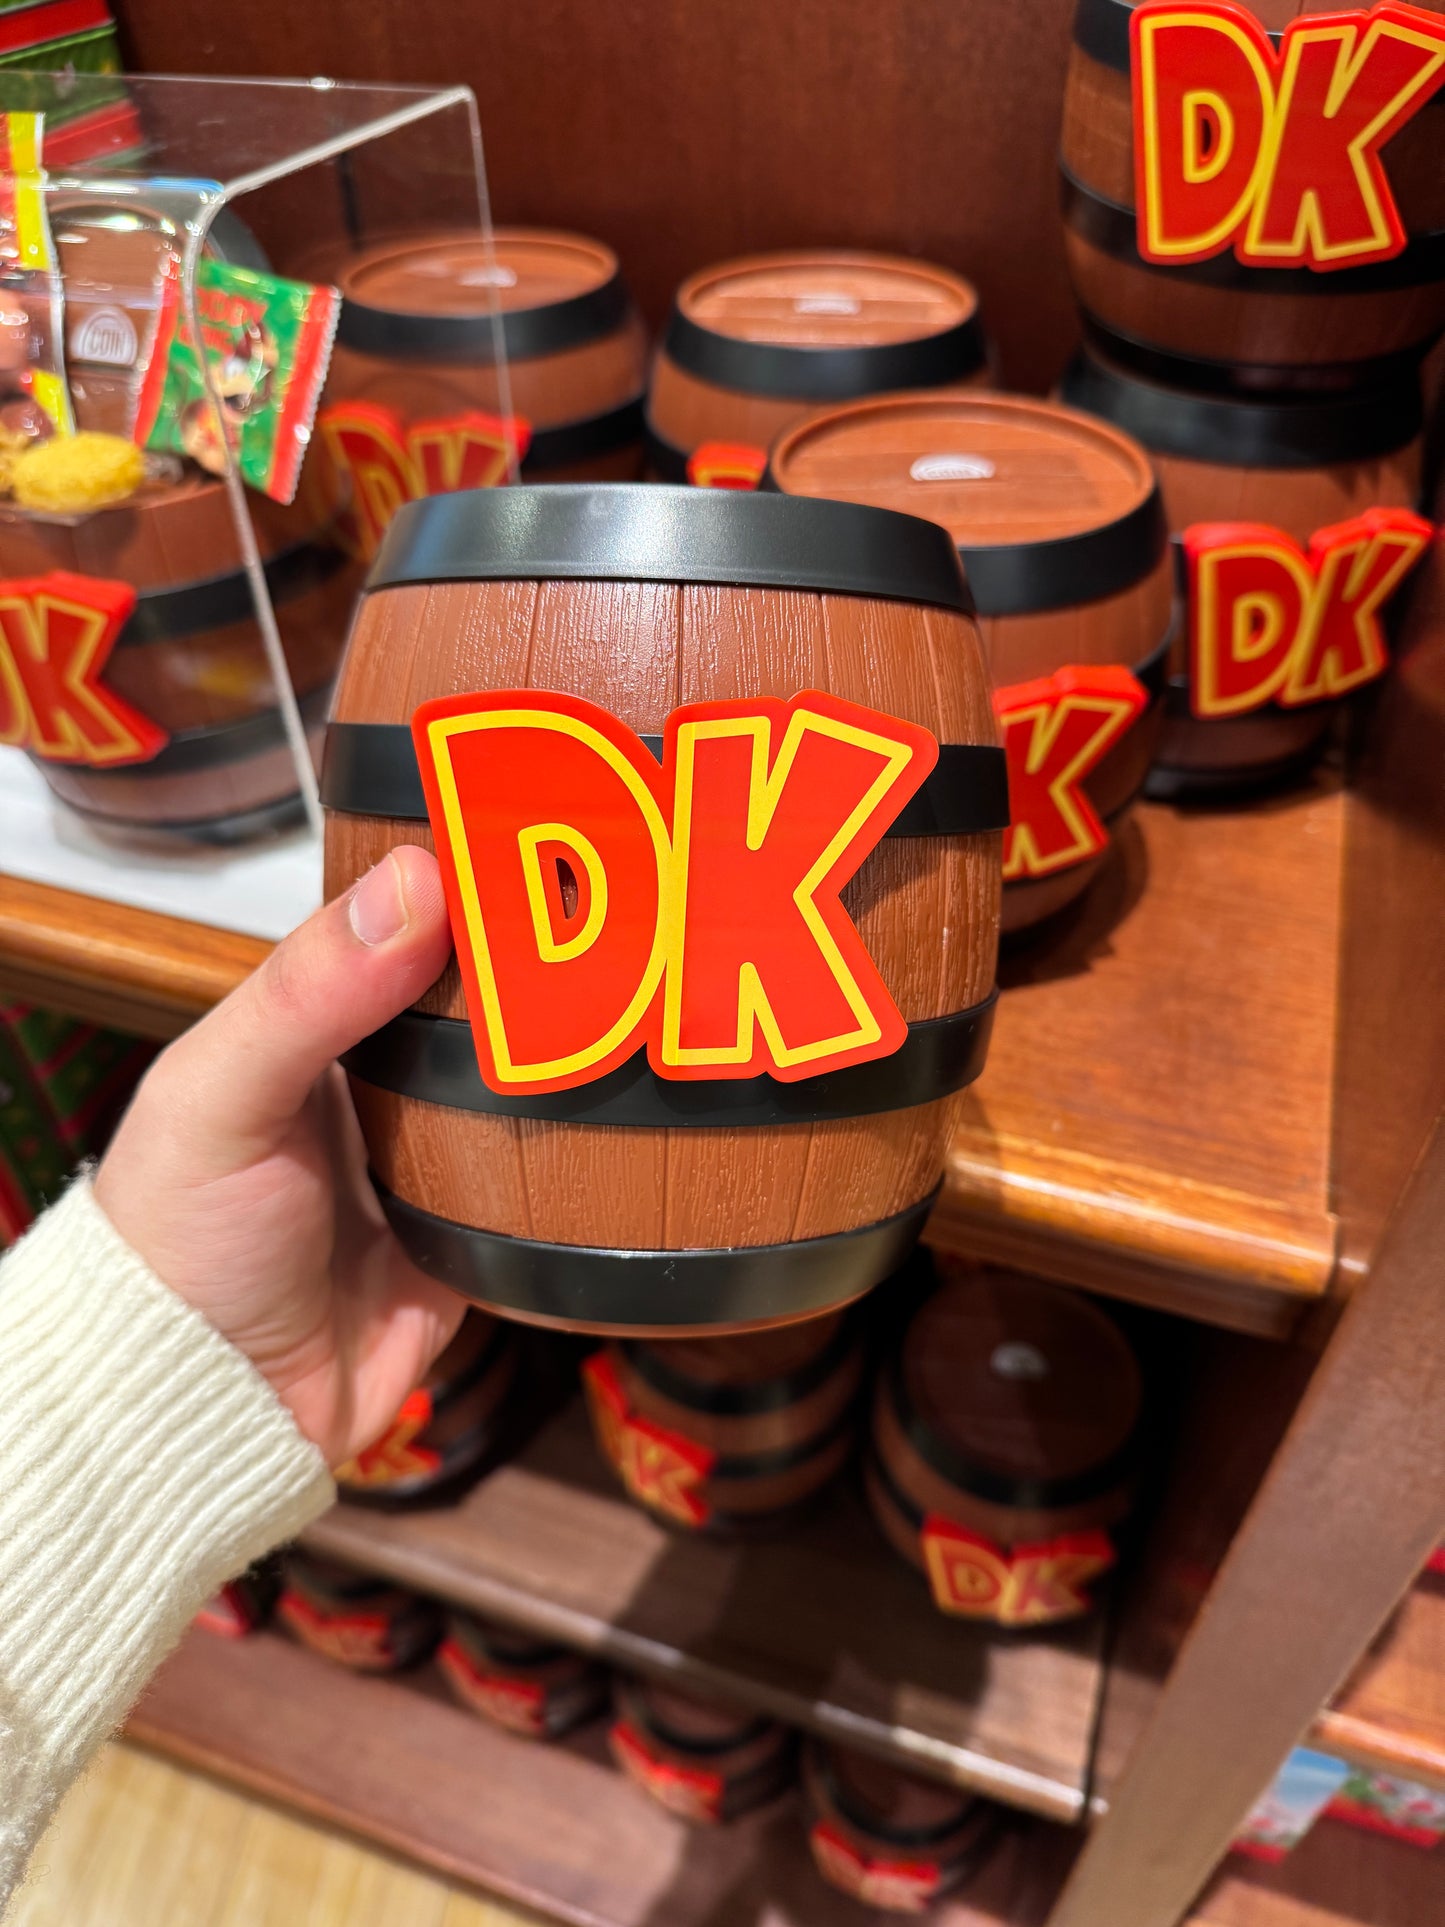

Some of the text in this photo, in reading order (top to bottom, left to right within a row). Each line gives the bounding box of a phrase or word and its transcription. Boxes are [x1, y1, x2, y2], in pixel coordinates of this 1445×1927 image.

[1138, 12, 1445, 262] DK
[0, 594, 146, 761] K
[1199, 529, 1427, 714] DK
[427, 708, 914, 1084] DK
